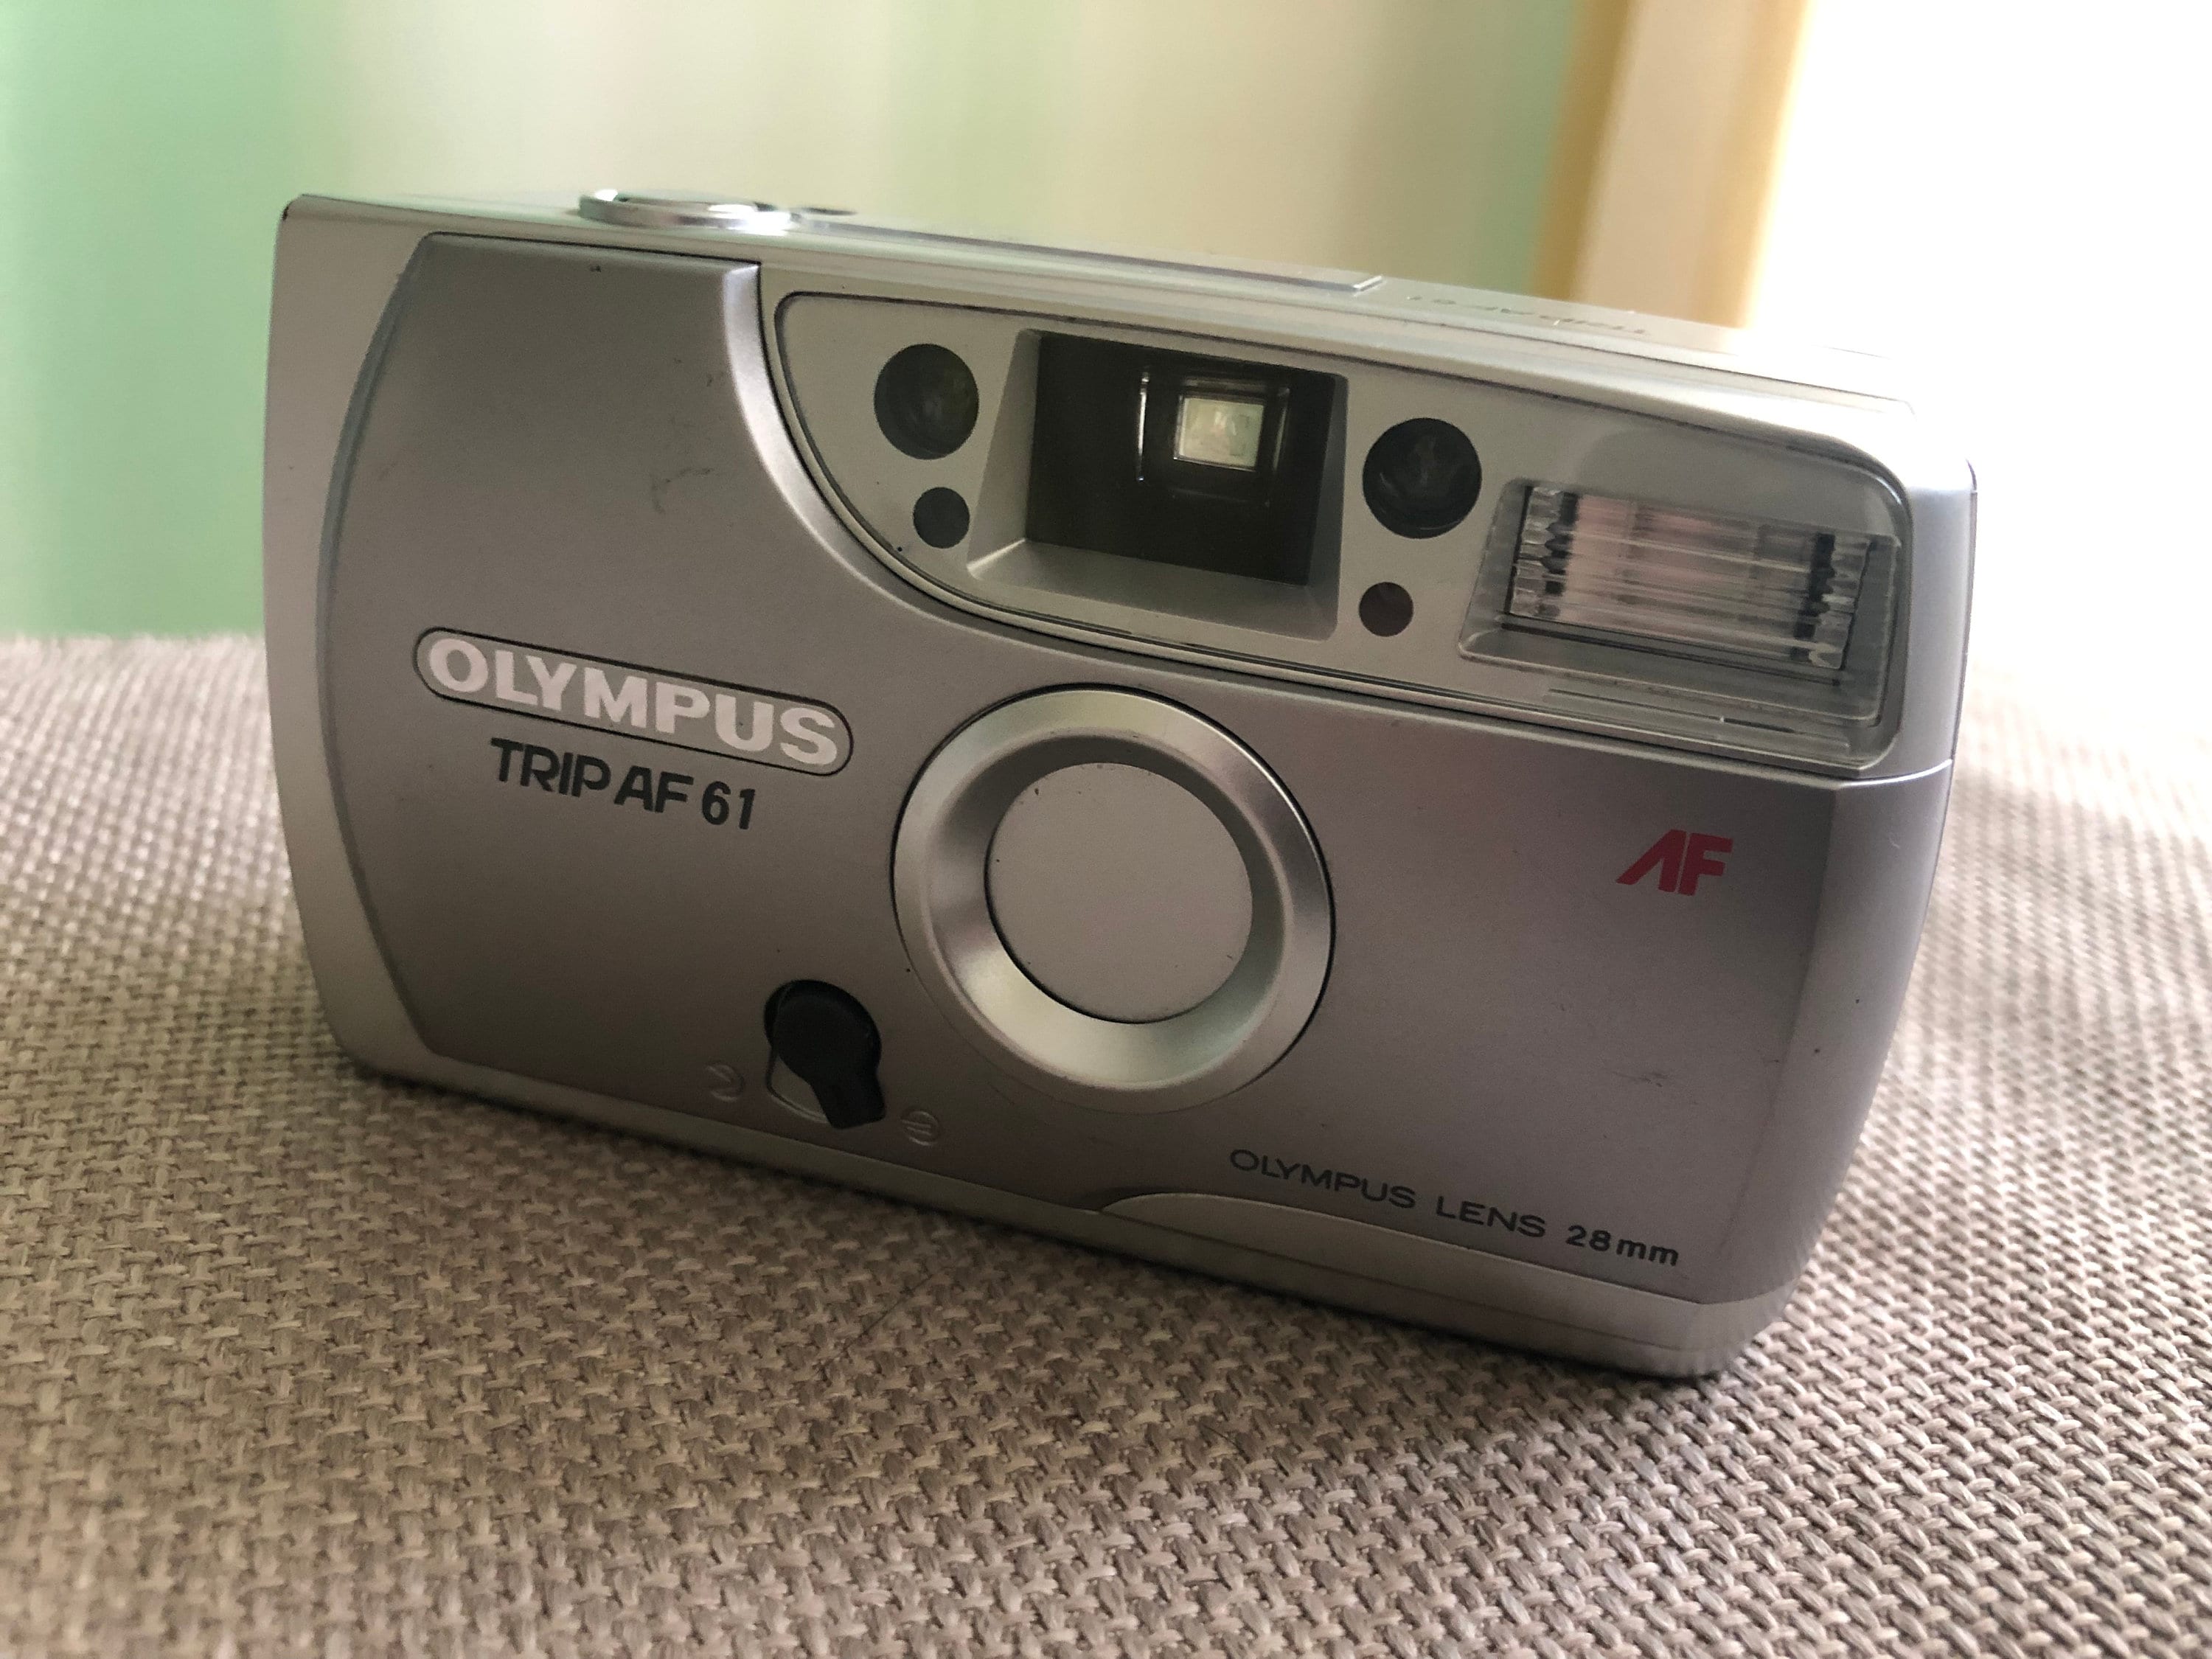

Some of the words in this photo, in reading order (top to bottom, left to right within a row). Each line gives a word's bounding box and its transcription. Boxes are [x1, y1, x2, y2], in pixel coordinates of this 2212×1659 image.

[428, 638, 838, 765] OLYMPUS
[490, 737, 611, 798] TRIP
[701, 781, 756, 830] 61
[1615, 829, 1733, 896] AF
[1229, 1149, 1417, 1209] OLYMPUS
[1436, 1195, 1547, 1238] LENS
[1566, 1225, 1679, 1267] 28mm
